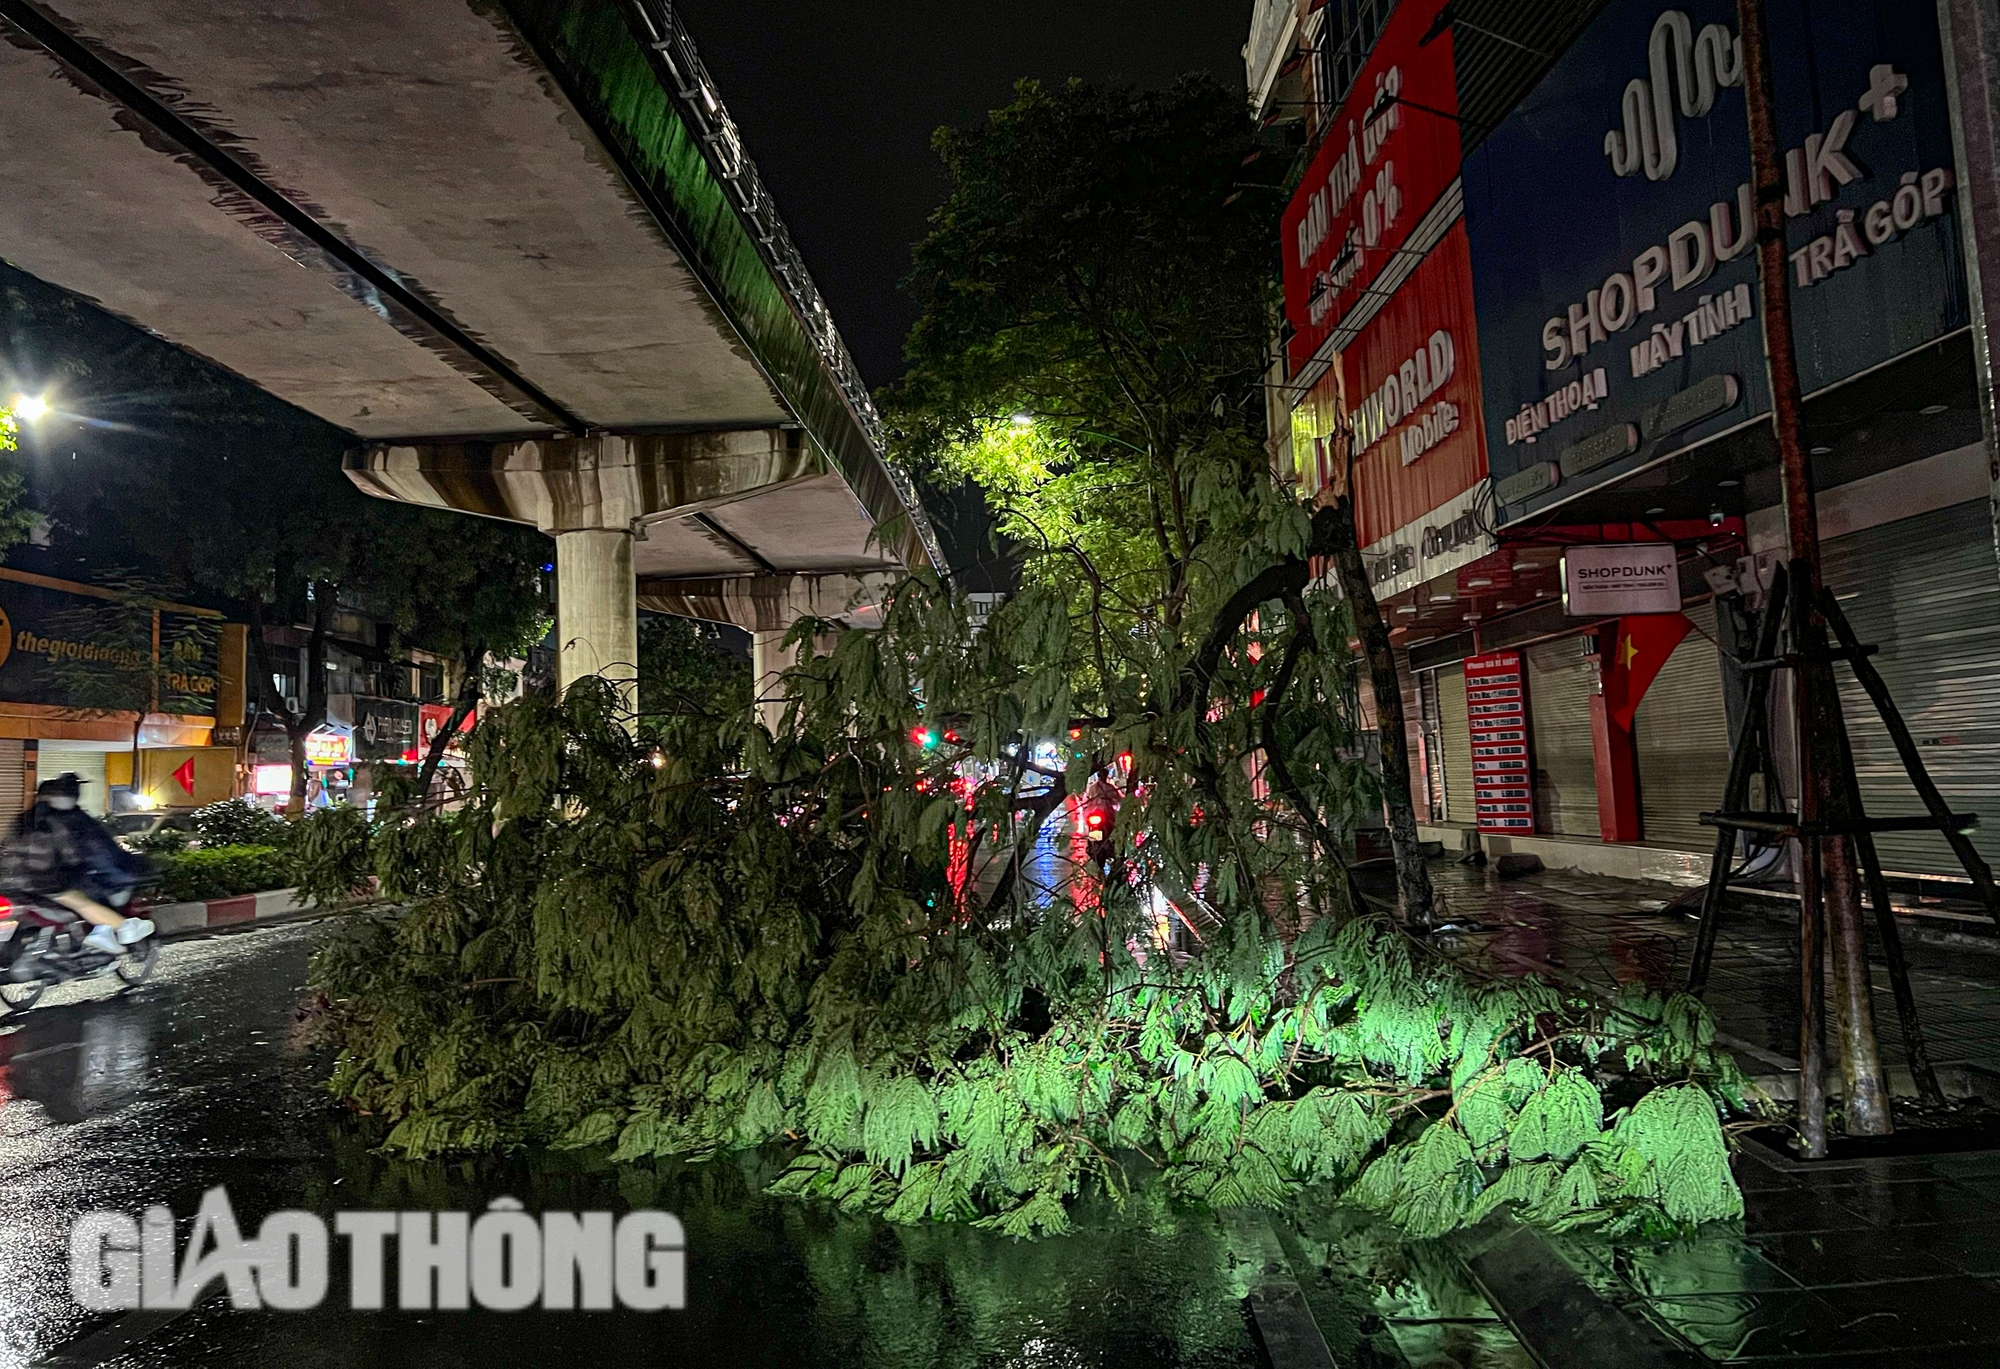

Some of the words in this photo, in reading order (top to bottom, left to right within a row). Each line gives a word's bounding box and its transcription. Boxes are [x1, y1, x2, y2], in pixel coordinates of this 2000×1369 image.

[1298, 186, 1330, 269] BÁN
[1505, 403, 1549, 446] ĐIỆN
[1545, 368, 1608, 424] THOẠI
[1630, 323, 1684, 378] MÁY
[1682, 283, 1752, 346] TÍNH
[1788, 208, 1869, 289] TRẢ
[1864, 166, 1952, 245] GÓP
[1349, 330, 1455, 460] HWORLD
